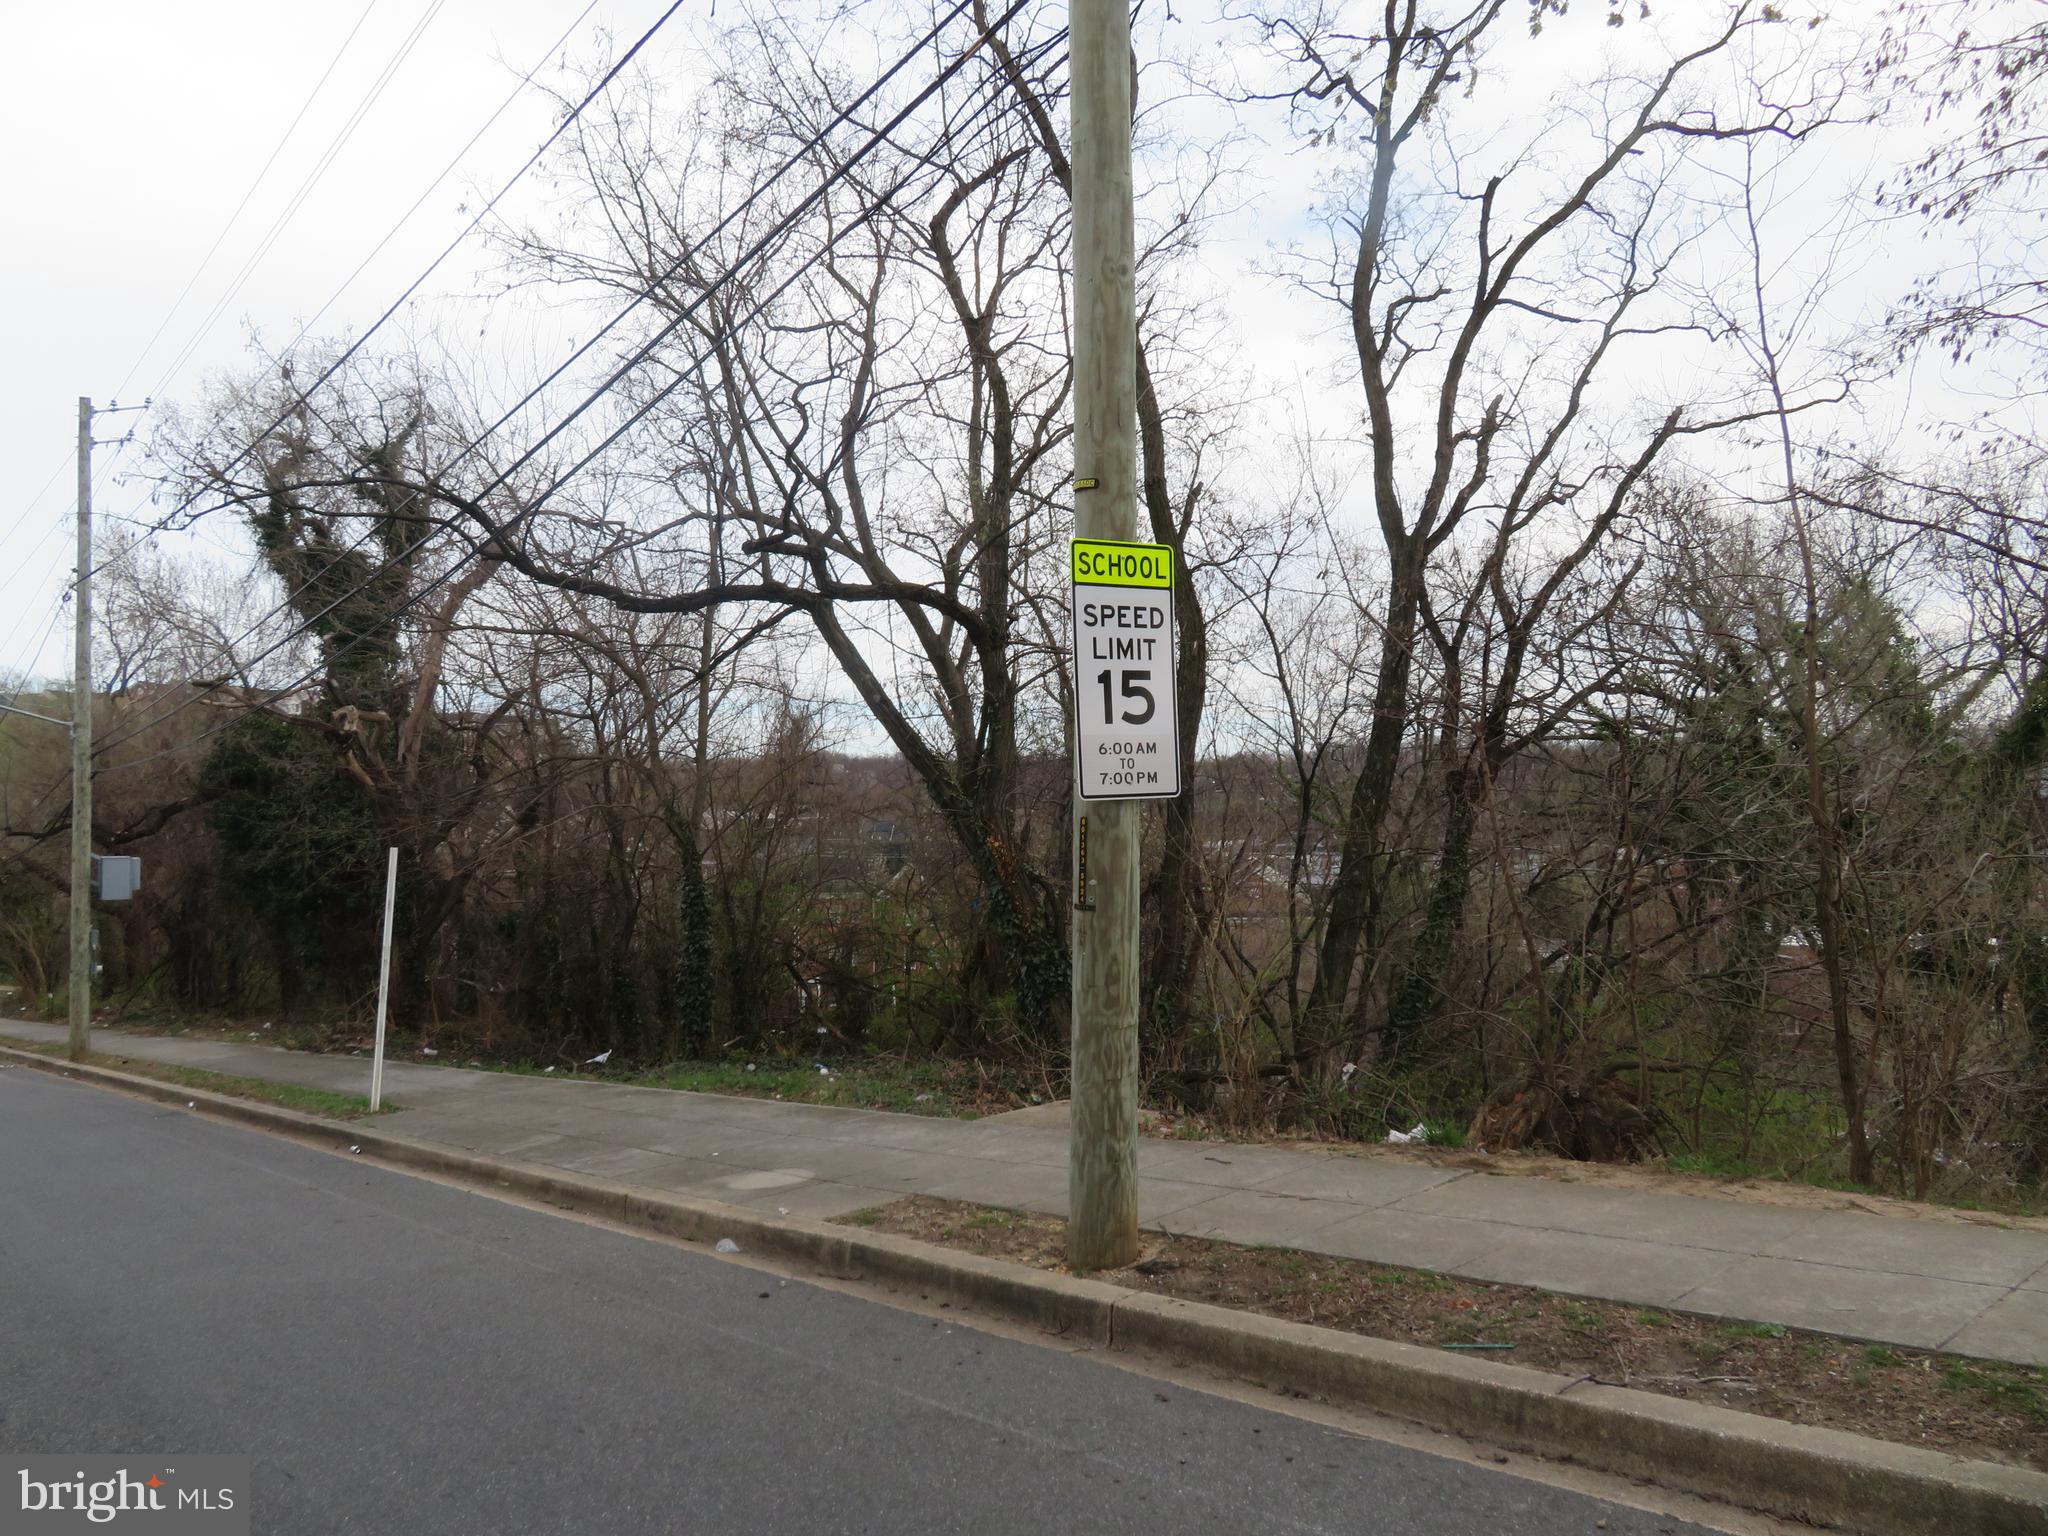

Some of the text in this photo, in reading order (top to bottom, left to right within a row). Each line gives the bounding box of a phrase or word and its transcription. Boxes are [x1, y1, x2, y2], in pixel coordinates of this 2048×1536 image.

[1078, 551, 1167, 580] SCHOOL
[1083, 603, 1164, 629] SPEED
[1092, 636, 1157, 661] LIMIT
[1097, 669, 1156, 726] 15
[1119, 757, 1135, 770] TO
